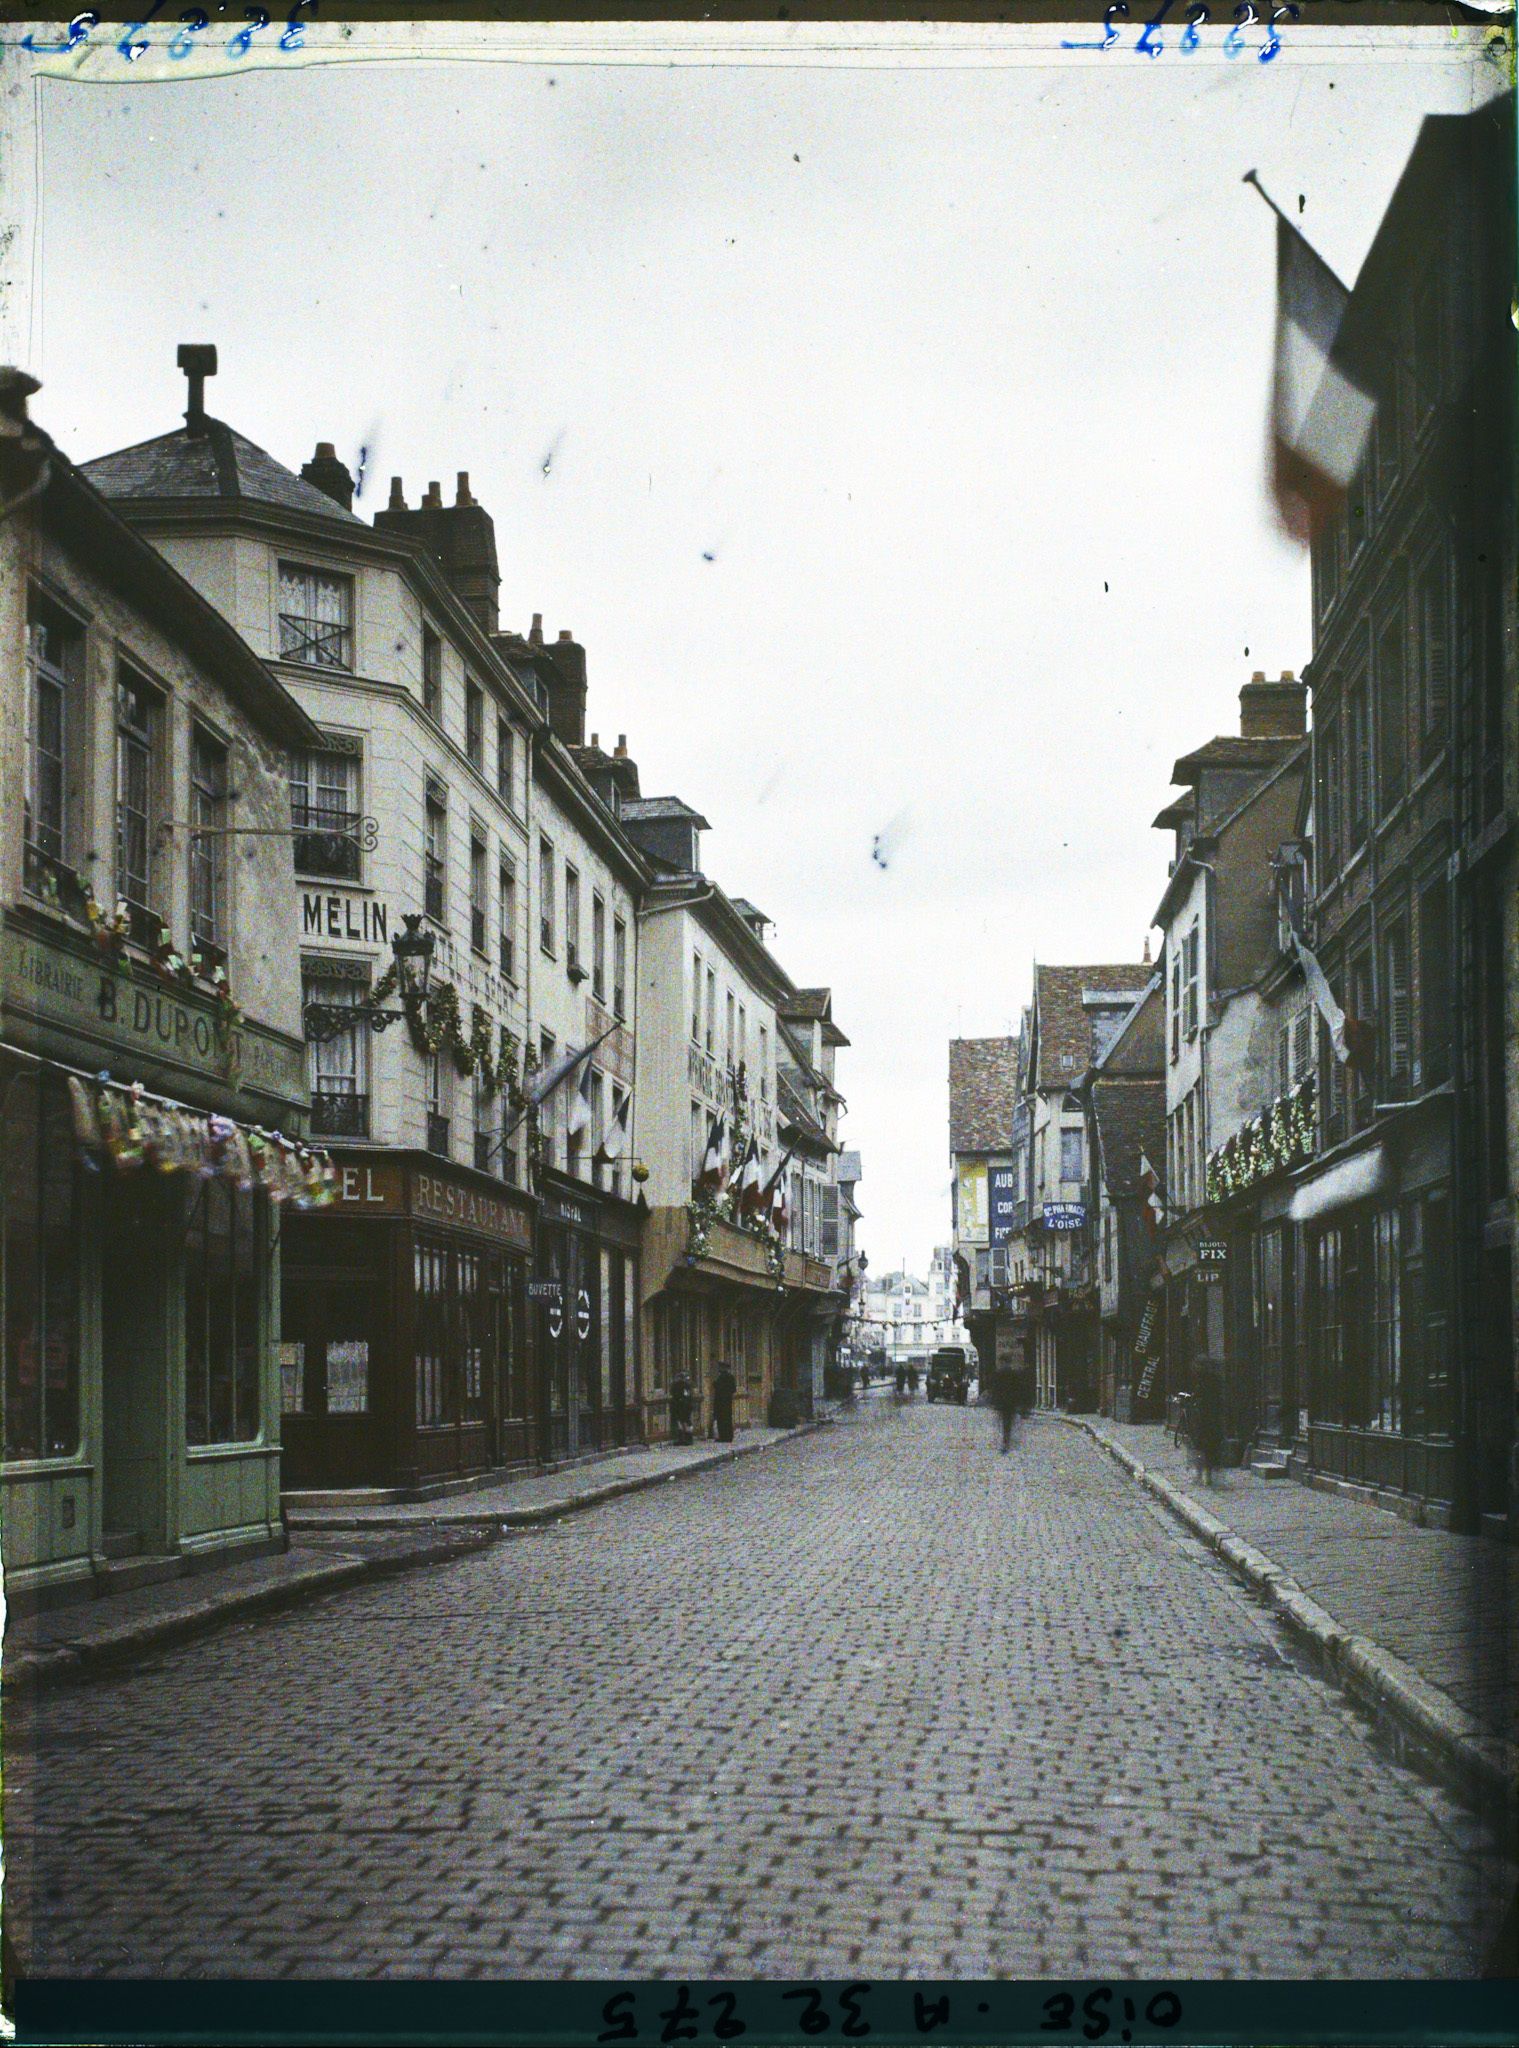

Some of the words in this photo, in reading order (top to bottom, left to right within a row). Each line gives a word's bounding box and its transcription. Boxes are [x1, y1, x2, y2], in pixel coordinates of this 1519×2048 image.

[418, 1174, 526, 1233] RESTAURANT
[1048, 1218, 1082, 1230] L'OISE
[1200, 1249, 1227, 1260] FIX
[1197, 1273, 1219, 1282] LIP
[528, 1283, 562, 1297] BUVETTE
[1137, 1355, 1160, 1399] CENTRAL
